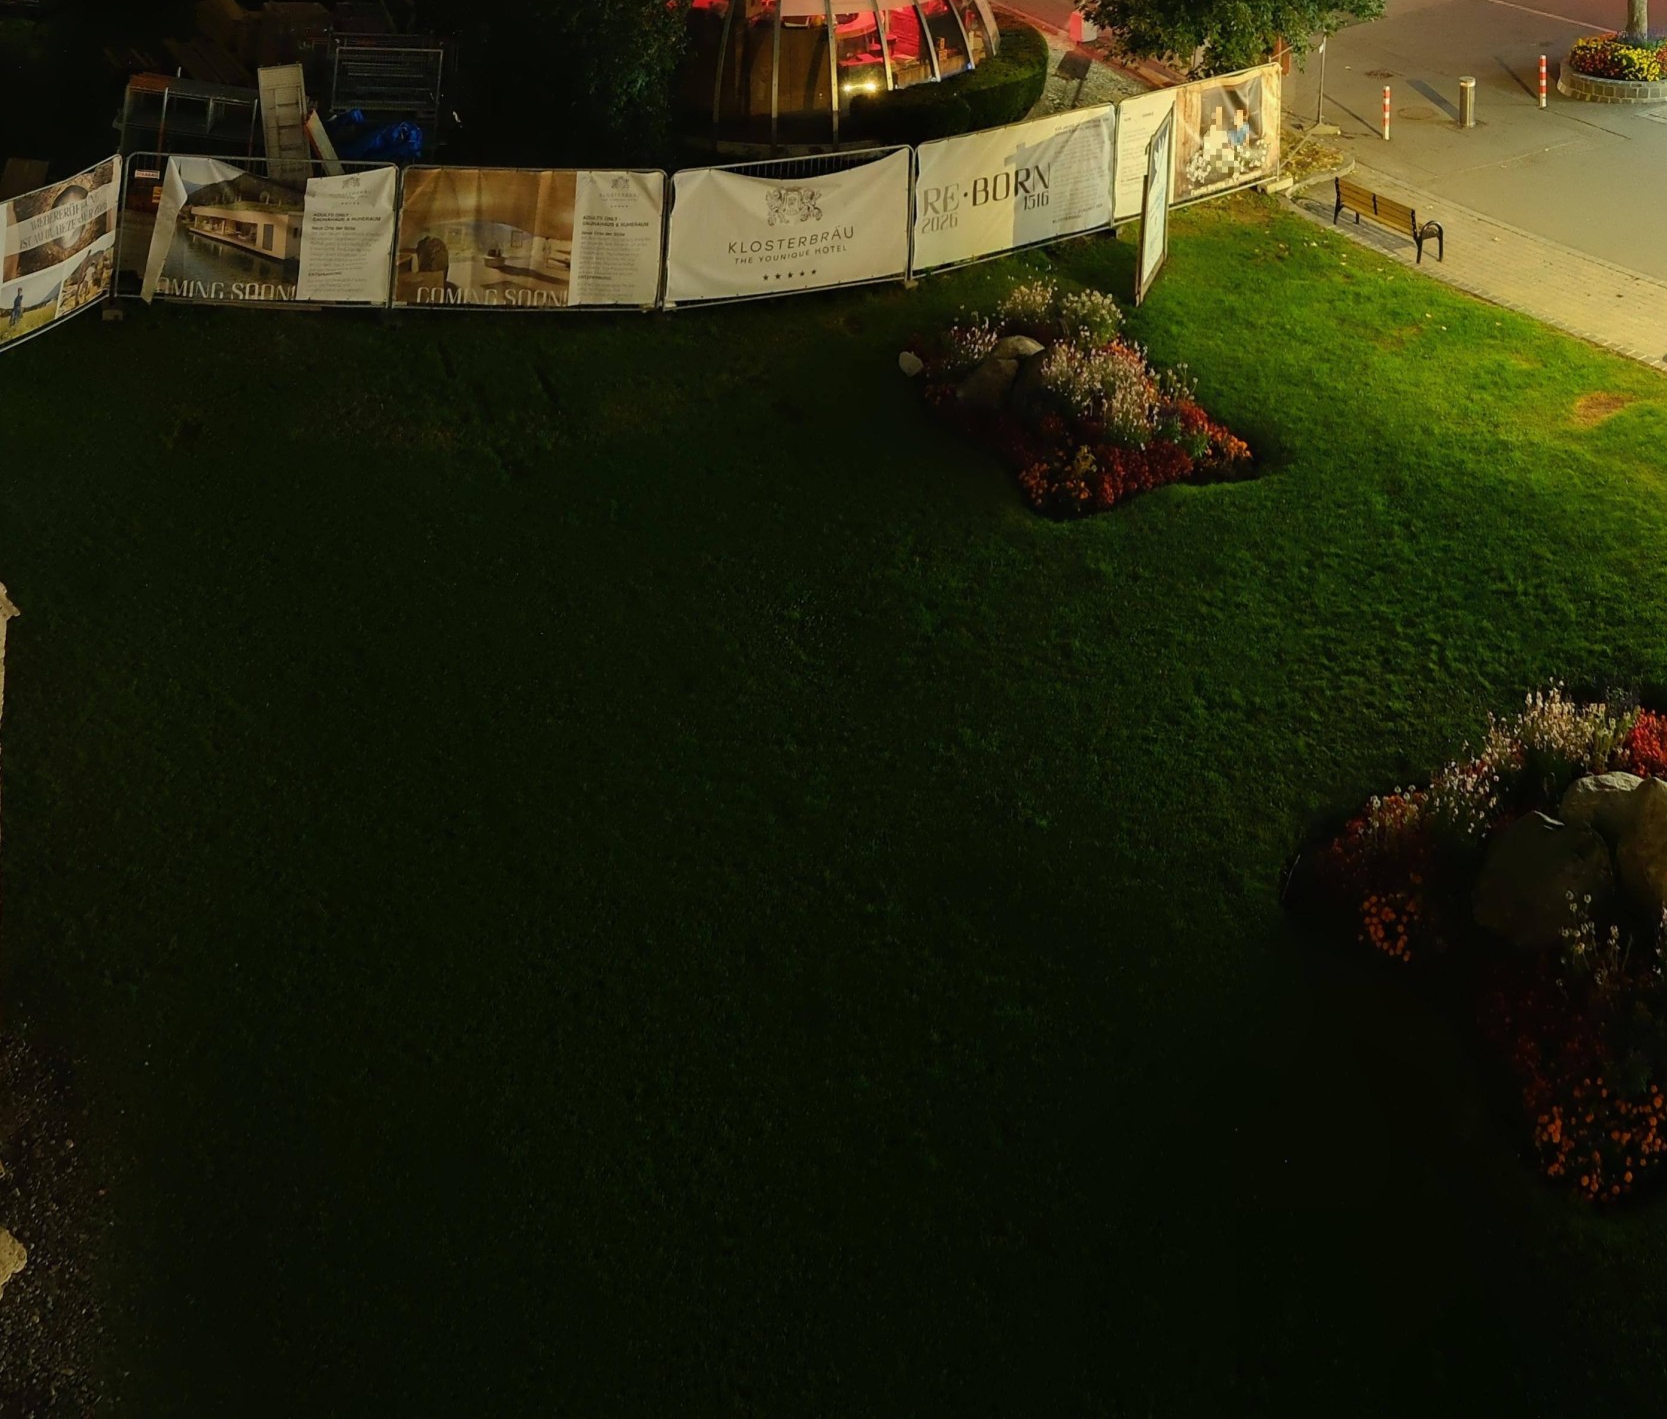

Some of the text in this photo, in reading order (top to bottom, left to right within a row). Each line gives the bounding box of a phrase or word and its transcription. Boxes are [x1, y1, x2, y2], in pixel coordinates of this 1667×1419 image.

[1023, 191, 1050, 211] 1516
[921, 213, 958, 235] 2026
[727, 225, 854, 255] KLOSTERBRÄU
[735, 245, 847, 265] THE YOUNIQUE HOTEL
[156, 277, 224, 299] OMING
